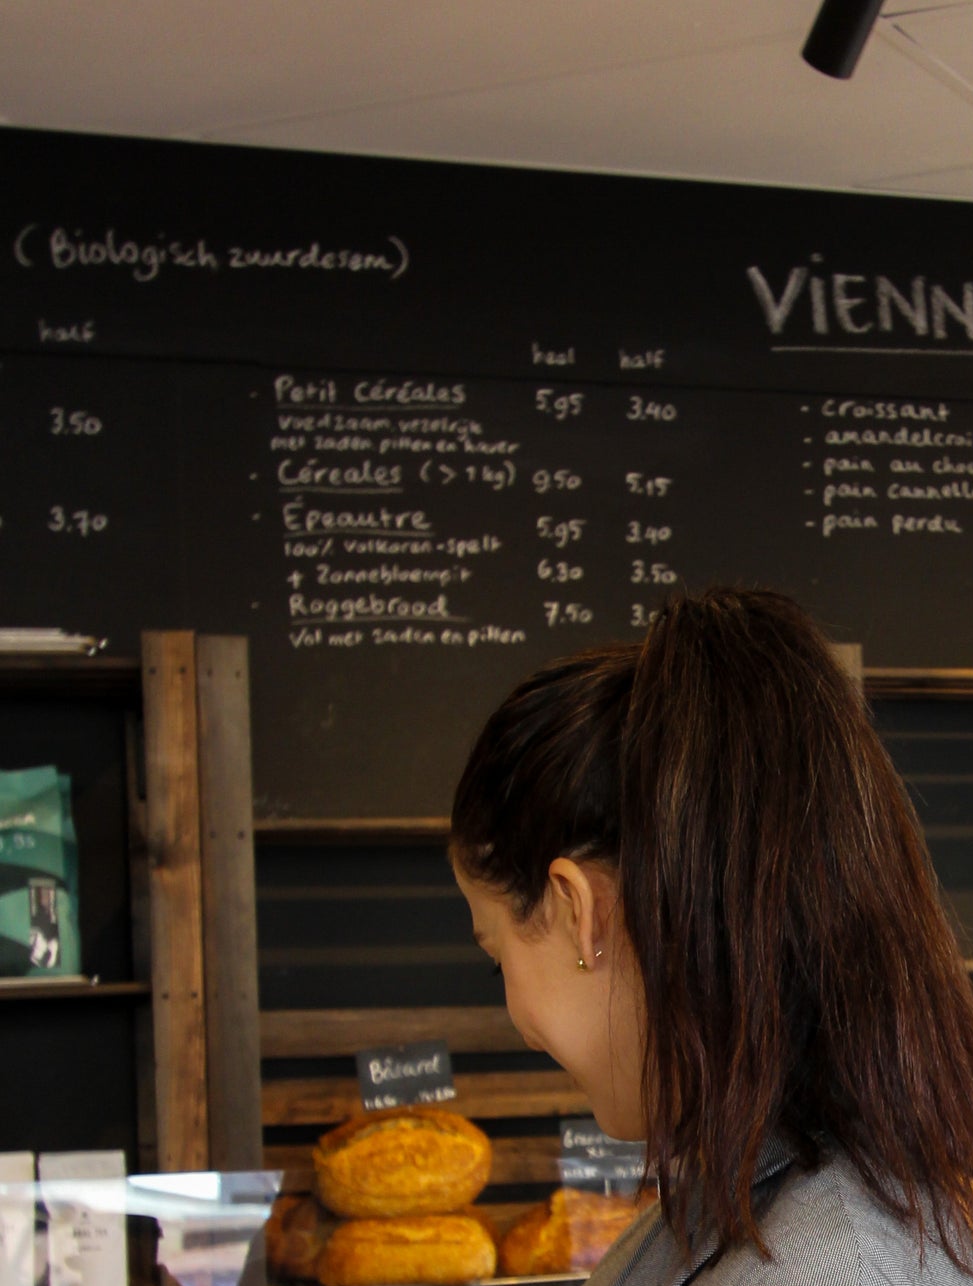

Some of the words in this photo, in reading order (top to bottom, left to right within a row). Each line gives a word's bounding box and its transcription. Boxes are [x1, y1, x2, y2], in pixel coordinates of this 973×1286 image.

[38, 319, 96, 343] half
[618, 348, 665, 370] half
[274, 374, 337, 403] Petit
[535, 388, 586, 421] 5.95
[626, 396, 678, 421] 3.40
[821, 400, 950, 421] croissant
[49, 407, 103, 436] 3.50
[823, 456, 875, 476] pain
[889, 460, 924, 474] au
[625, 472, 674, 497] 5.15
[823, 482, 877, 507] pain
[46, 503, 109, 538] 3.70
[536, 515, 588, 549] 5.95
[822, 509, 879, 538] pain
[890, 513, 964, 535] perdu
[537, 557, 585, 583] 6.30
[630, 559, 678, 584] 3.50
[289, 592, 450, 622] Roggebrood
[543, 600, 593, 627] 7.50
